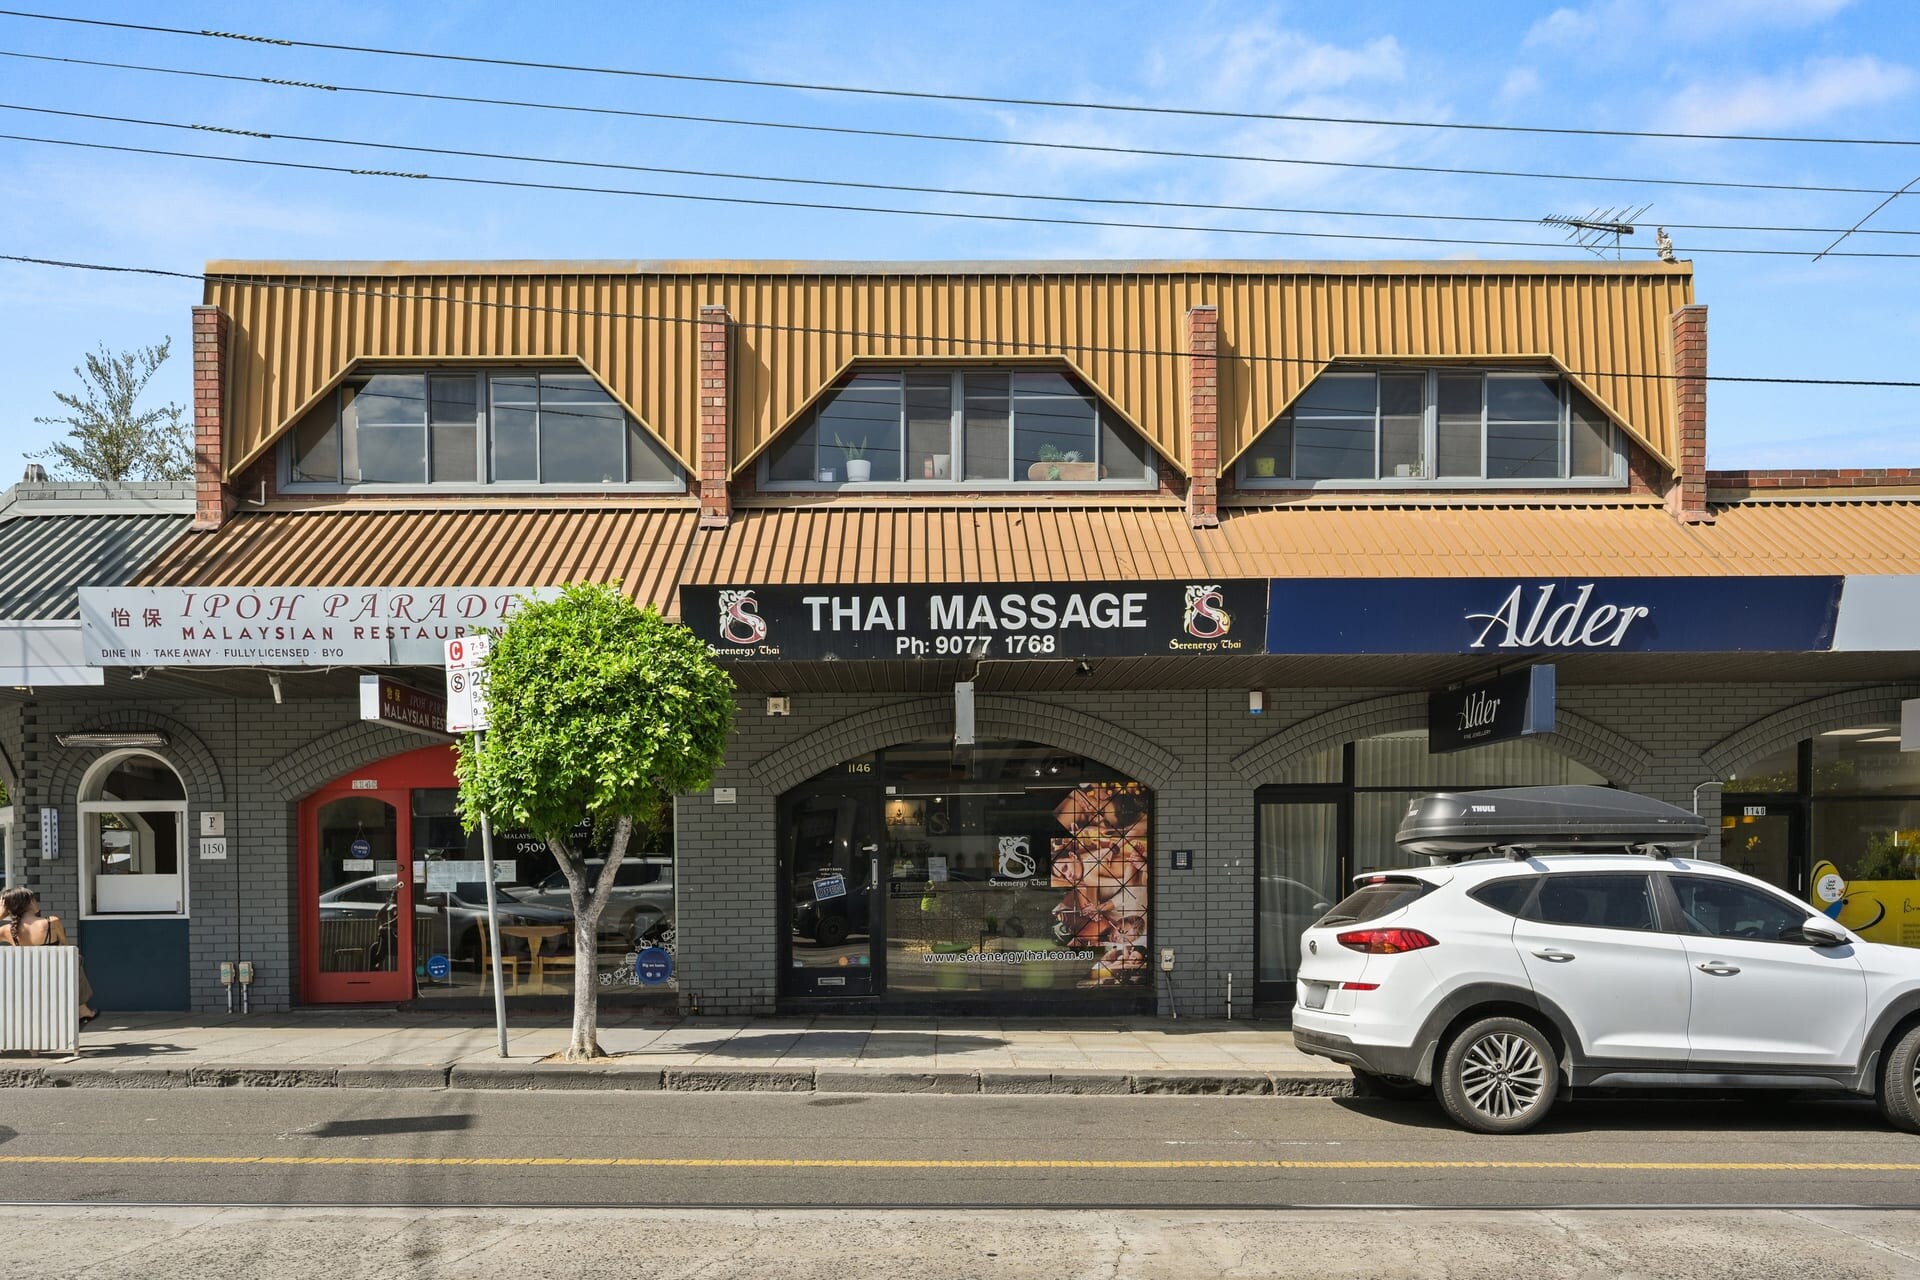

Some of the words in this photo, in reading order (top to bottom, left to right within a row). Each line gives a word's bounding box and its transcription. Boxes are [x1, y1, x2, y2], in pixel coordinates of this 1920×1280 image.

[180, 593, 306, 621] IPOH
[322, 592, 519, 624] PARADE
[802, 596, 906, 631] THAI
[930, 592, 1149, 631] MASSAGE
[111, 607, 162, 628] 怡保
[1464, 583, 1649, 648] Alder
[182, 626, 334, 640] MALAYSIAN
[354, 626, 504, 640] RESTAURN
[707, 644, 756, 657] Serenergy
[759, 645, 780, 655] Thai
[896, 636, 930, 654] Ph:
[935, 635, 993, 654] 9077
[1004, 634, 1056, 653] 1768
[1169, 638, 1218, 651] Serenergy
[1220, 639, 1242, 650] Thai
[102, 649, 127, 658] DINE
[131, 649, 141, 658] IN
[322, 648, 344, 658] BYO
[384, 702, 430, 728] MALAYSIAN
[1457, 690, 1501, 730] Alder
[848, 763, 871, 773] 1146
[1745, 807, 1766, 815] 1140
[202, 843, 225, 854] 1150
[516, 842, 546, 854] 9509
[989, 878, 1028, 888] Serenergy
[1030, 878, 1048, 886] Thai
[923, 950, 1094, 964] www.serenergythai.com.au
